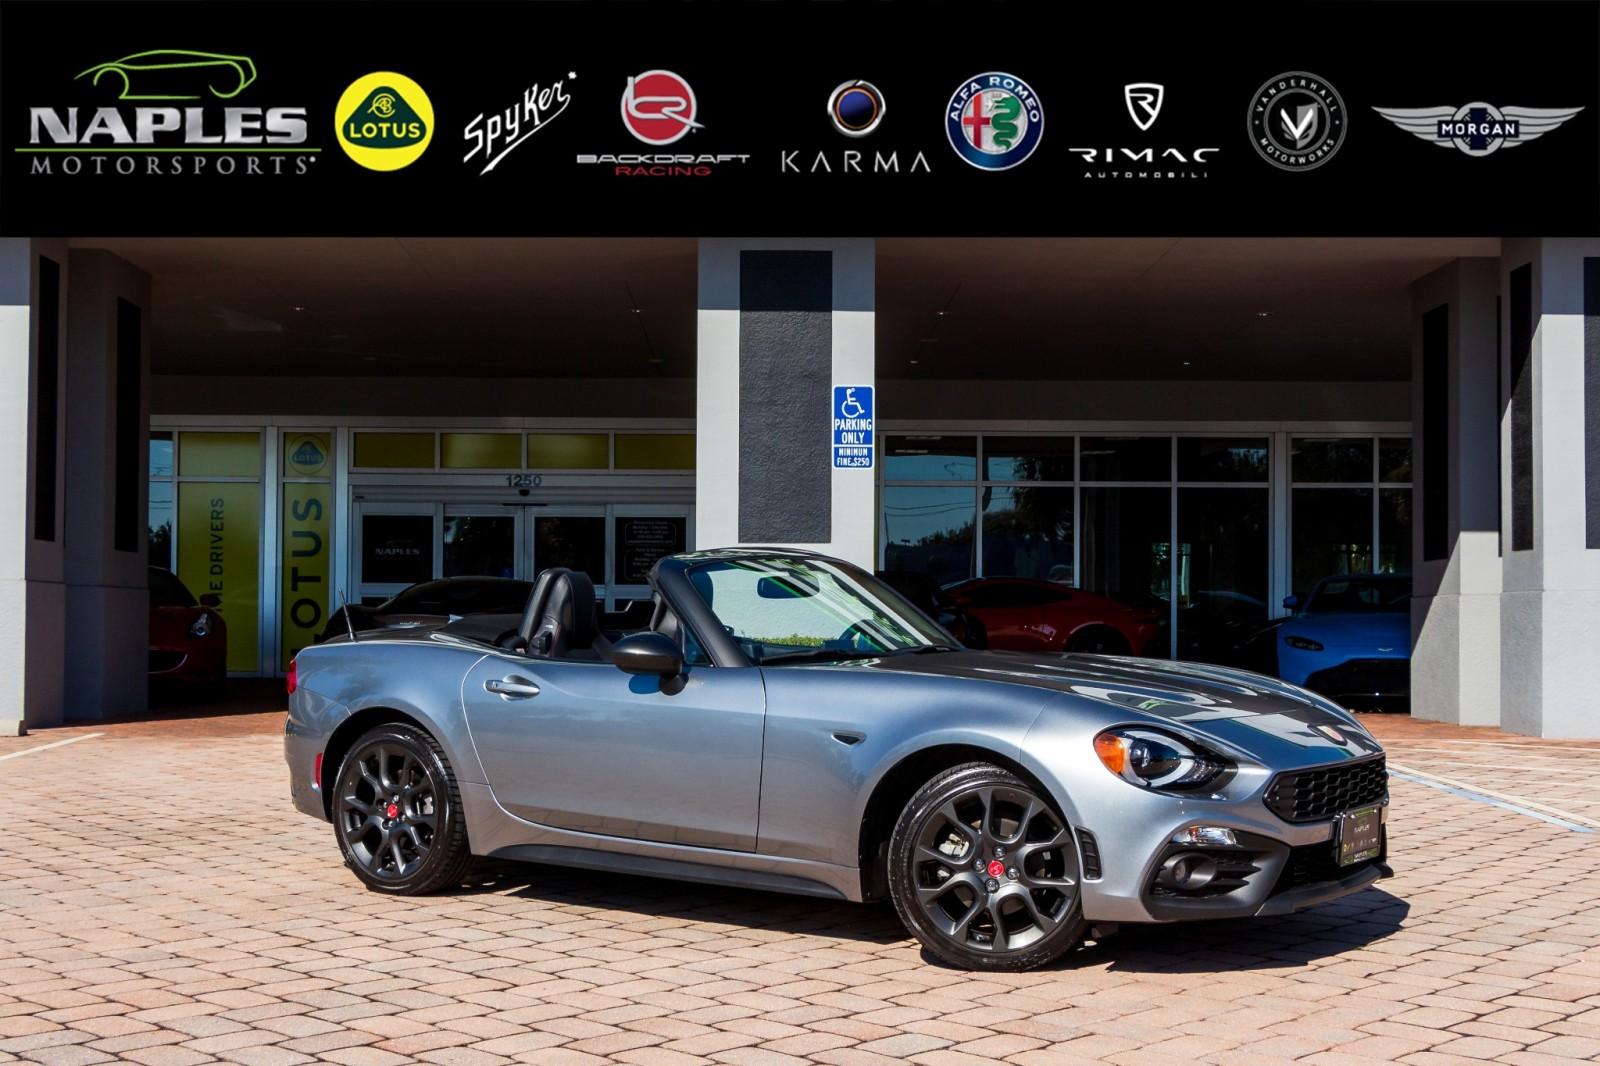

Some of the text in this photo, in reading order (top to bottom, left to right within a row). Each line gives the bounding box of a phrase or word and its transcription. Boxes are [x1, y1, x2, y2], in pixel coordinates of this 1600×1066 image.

[835, 419, 872, 430] PARKING
[841, 432, 864, 443] ONLY
[838, 447, 867, 456] MINIMUM
[505, 473, 543, 487] 1250
[210, 498, 224, 576] DRIVERS
